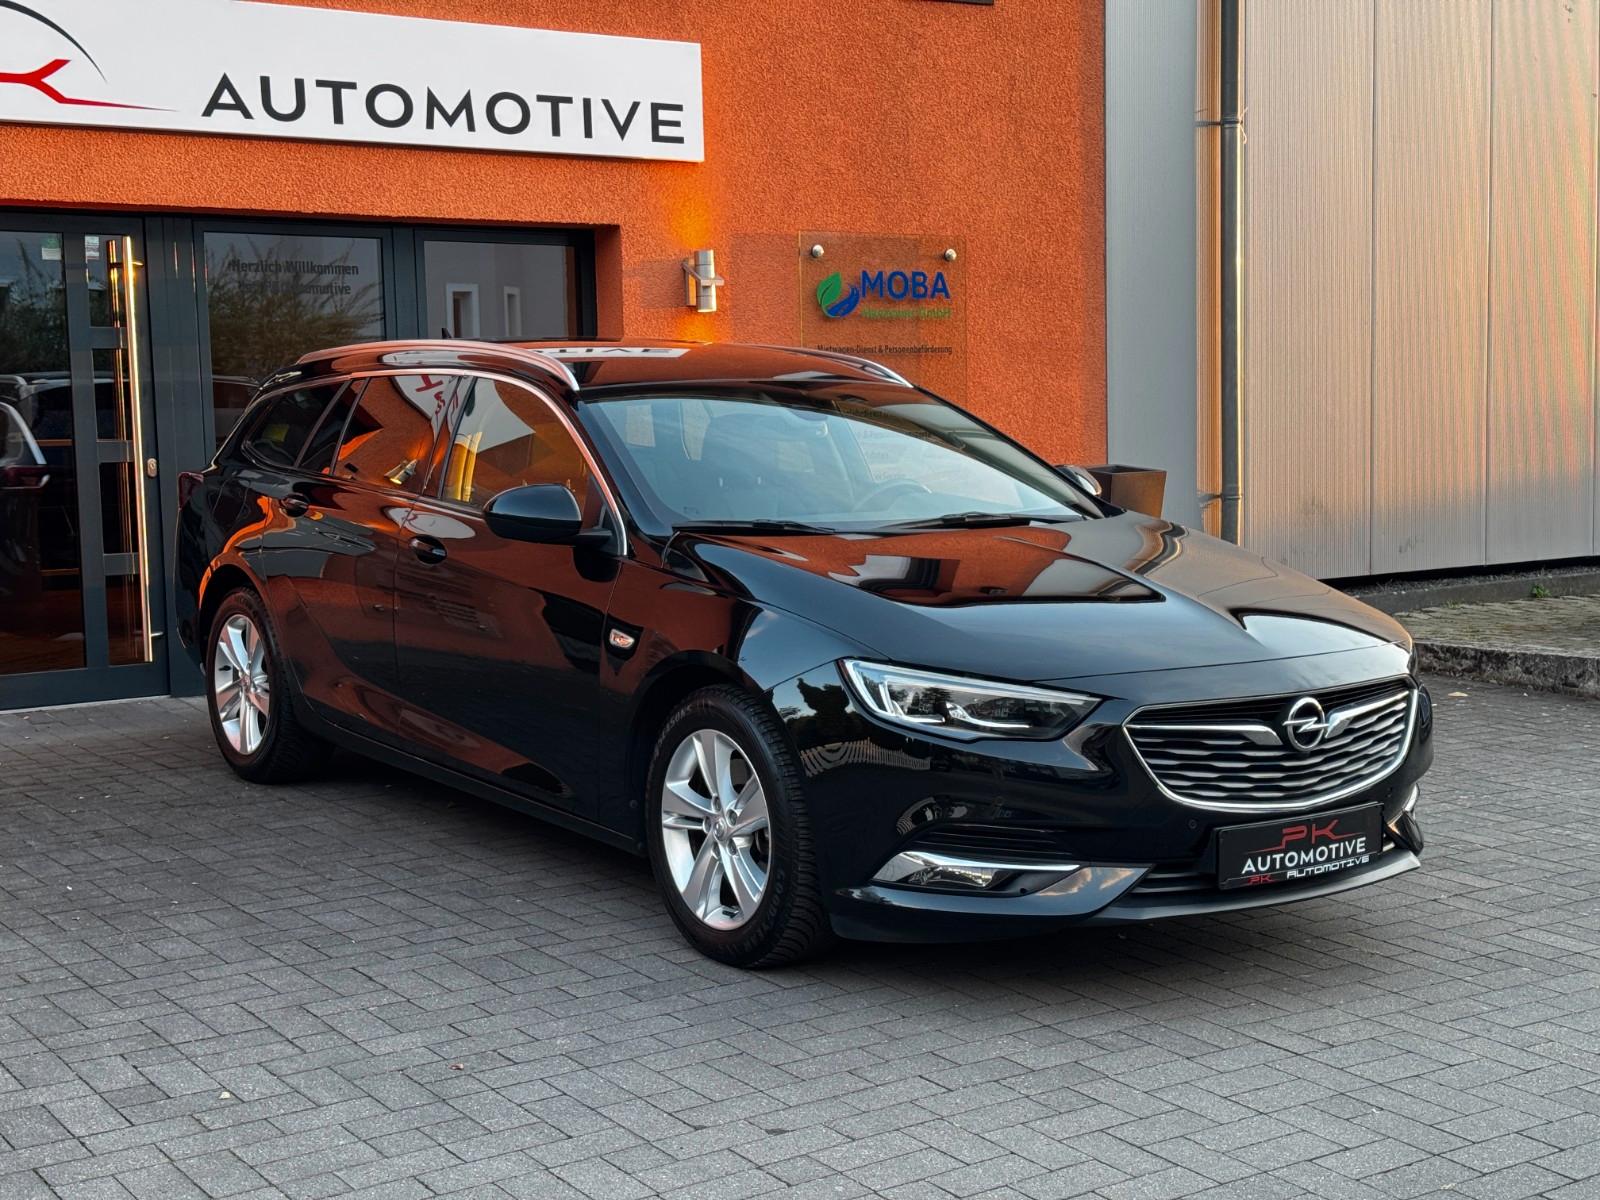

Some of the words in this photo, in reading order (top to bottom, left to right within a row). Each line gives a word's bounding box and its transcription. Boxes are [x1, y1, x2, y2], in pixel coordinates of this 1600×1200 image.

[201, 72, 685, 144] AUTOMOTIVE
[231, 259, 282, 273] Herzlich
[286, 260, 359, 275] Willkommen
[861, 270, 950, 299] MOBA
[1241, 837, 1366, 874] AUTOMOTIVE
[1248, 873, 1274, 885] PK
[1287, 855, 1370, 879] AUTOMOTIVE
